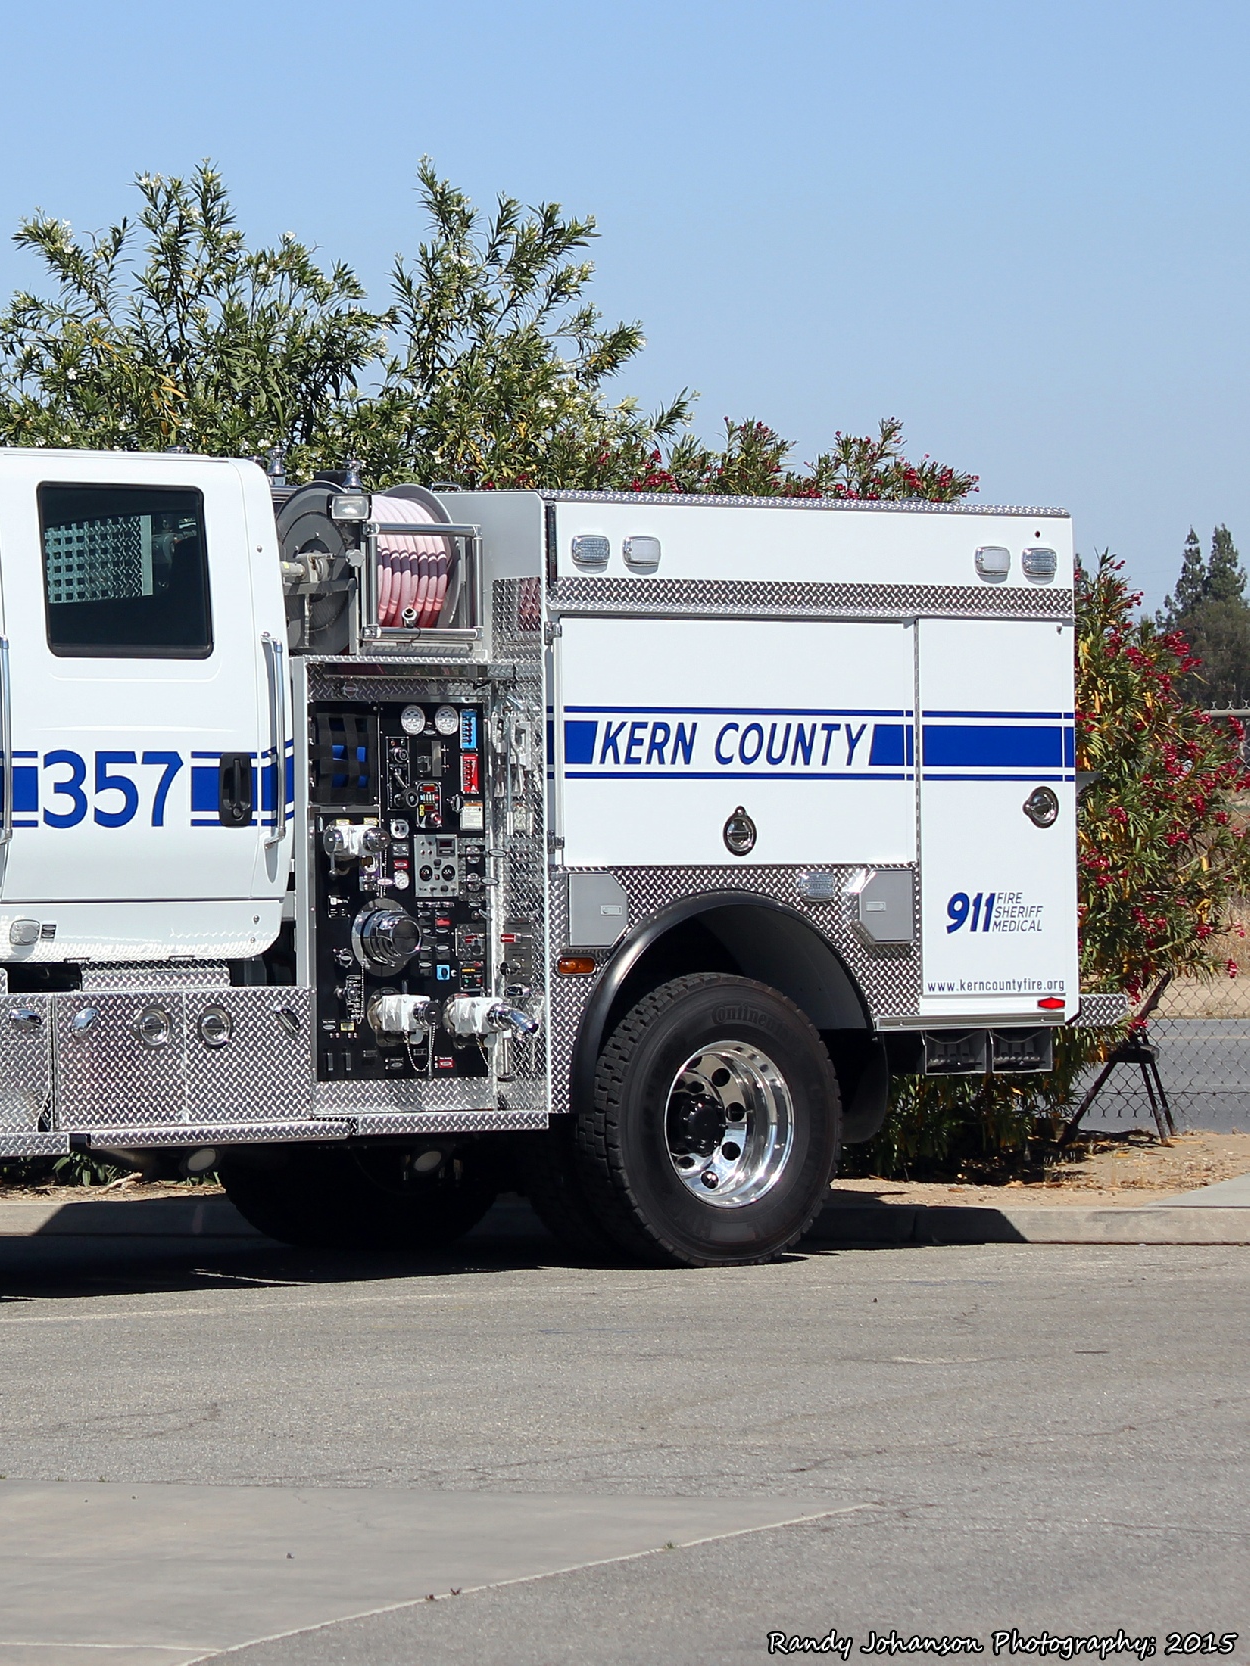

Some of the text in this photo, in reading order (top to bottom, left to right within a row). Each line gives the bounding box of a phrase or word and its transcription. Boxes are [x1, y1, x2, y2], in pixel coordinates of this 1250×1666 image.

[599, 721, 868, 767] KERN COUNTY
[42, 749, 185, 829] 357
[996, 892, 1023, 904] FIRE
[946, 892, 996, 935] 911
[994, 905, 1043, 919] SHERIFF
[992, 920, 1043, 932] MEDICAL
[927, 978, 1066, 993] www.kerncountyfire.org
